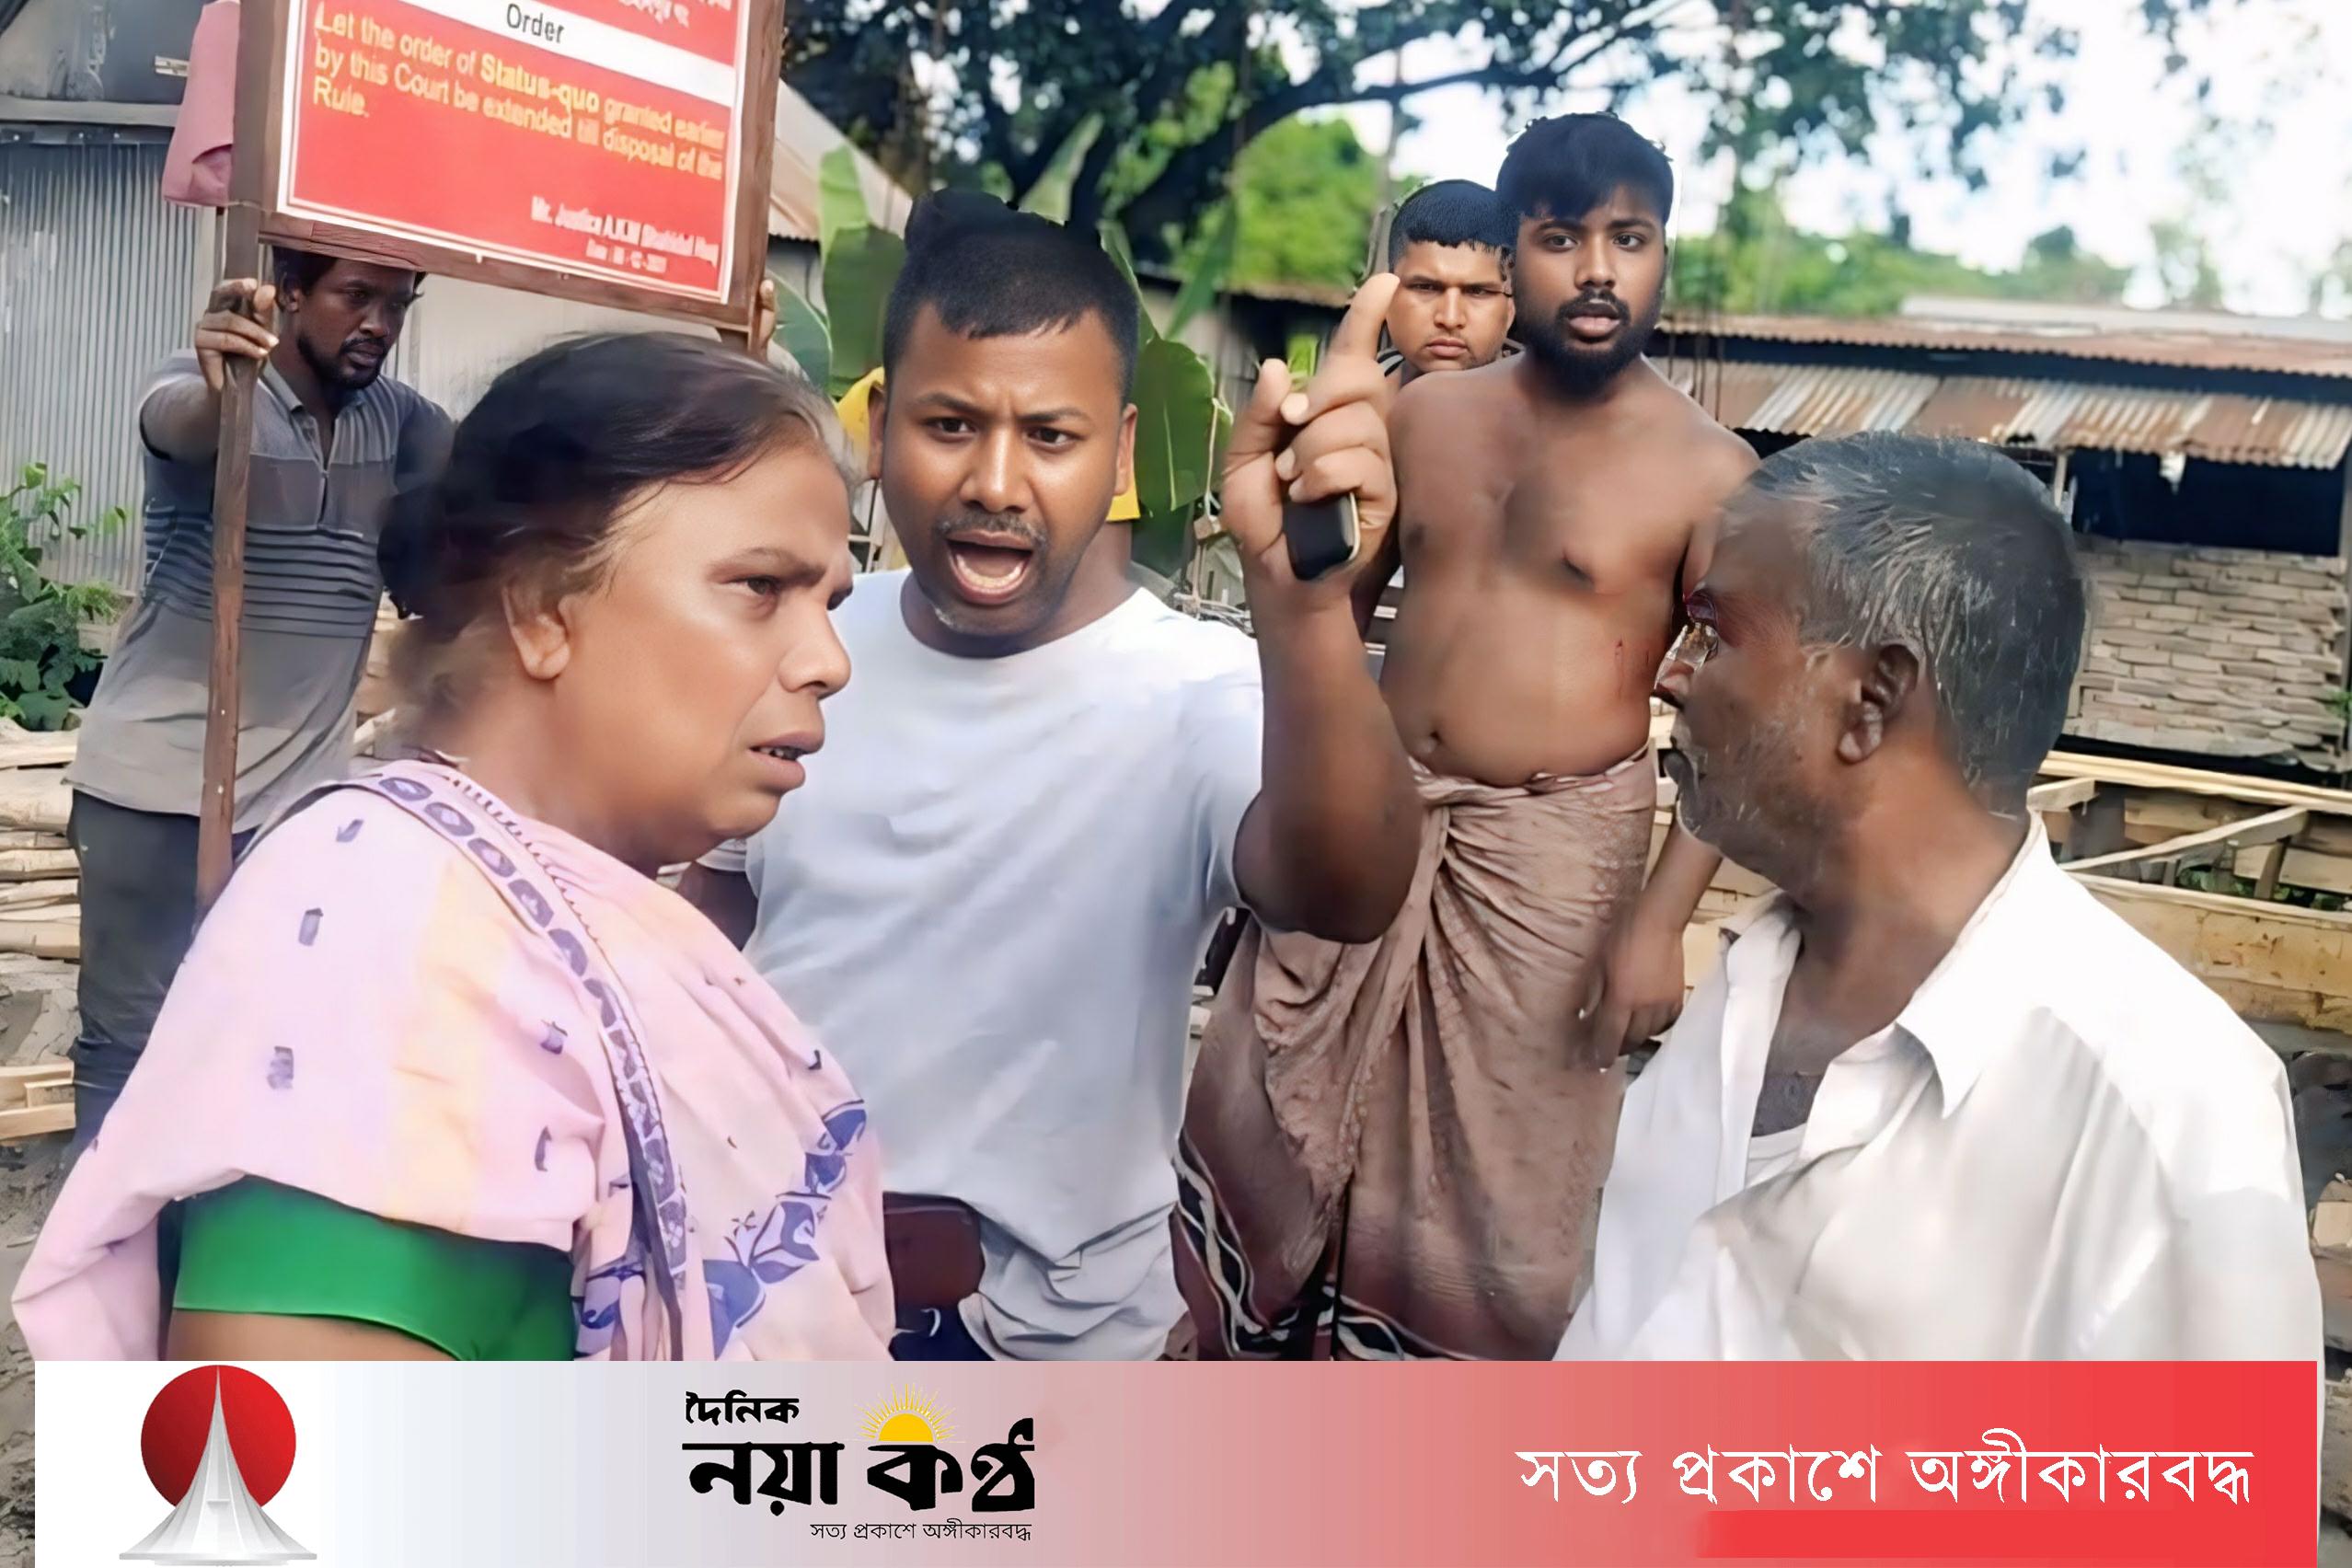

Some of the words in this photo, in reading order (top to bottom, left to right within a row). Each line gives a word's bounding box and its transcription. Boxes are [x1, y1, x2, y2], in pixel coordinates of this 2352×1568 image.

[314, 2, 355, 40] Let
[361, 16, 395, 50] the
[399, 33, 454, 69] order
[455, 50, 478, 76] of
[480, 53, 600, 113] Status-quo
[506, 3, 564, 42] Order
[313, 75, 370, 118] Rule.
[315, 40, 344, 78] by
[350, 51, 389, 86] this
[394, 62, 450, 105] Court
[454, 79, 479, 112] be
[482, 96, 572, 139] extended
[603, 127, 675, 168] disposal
